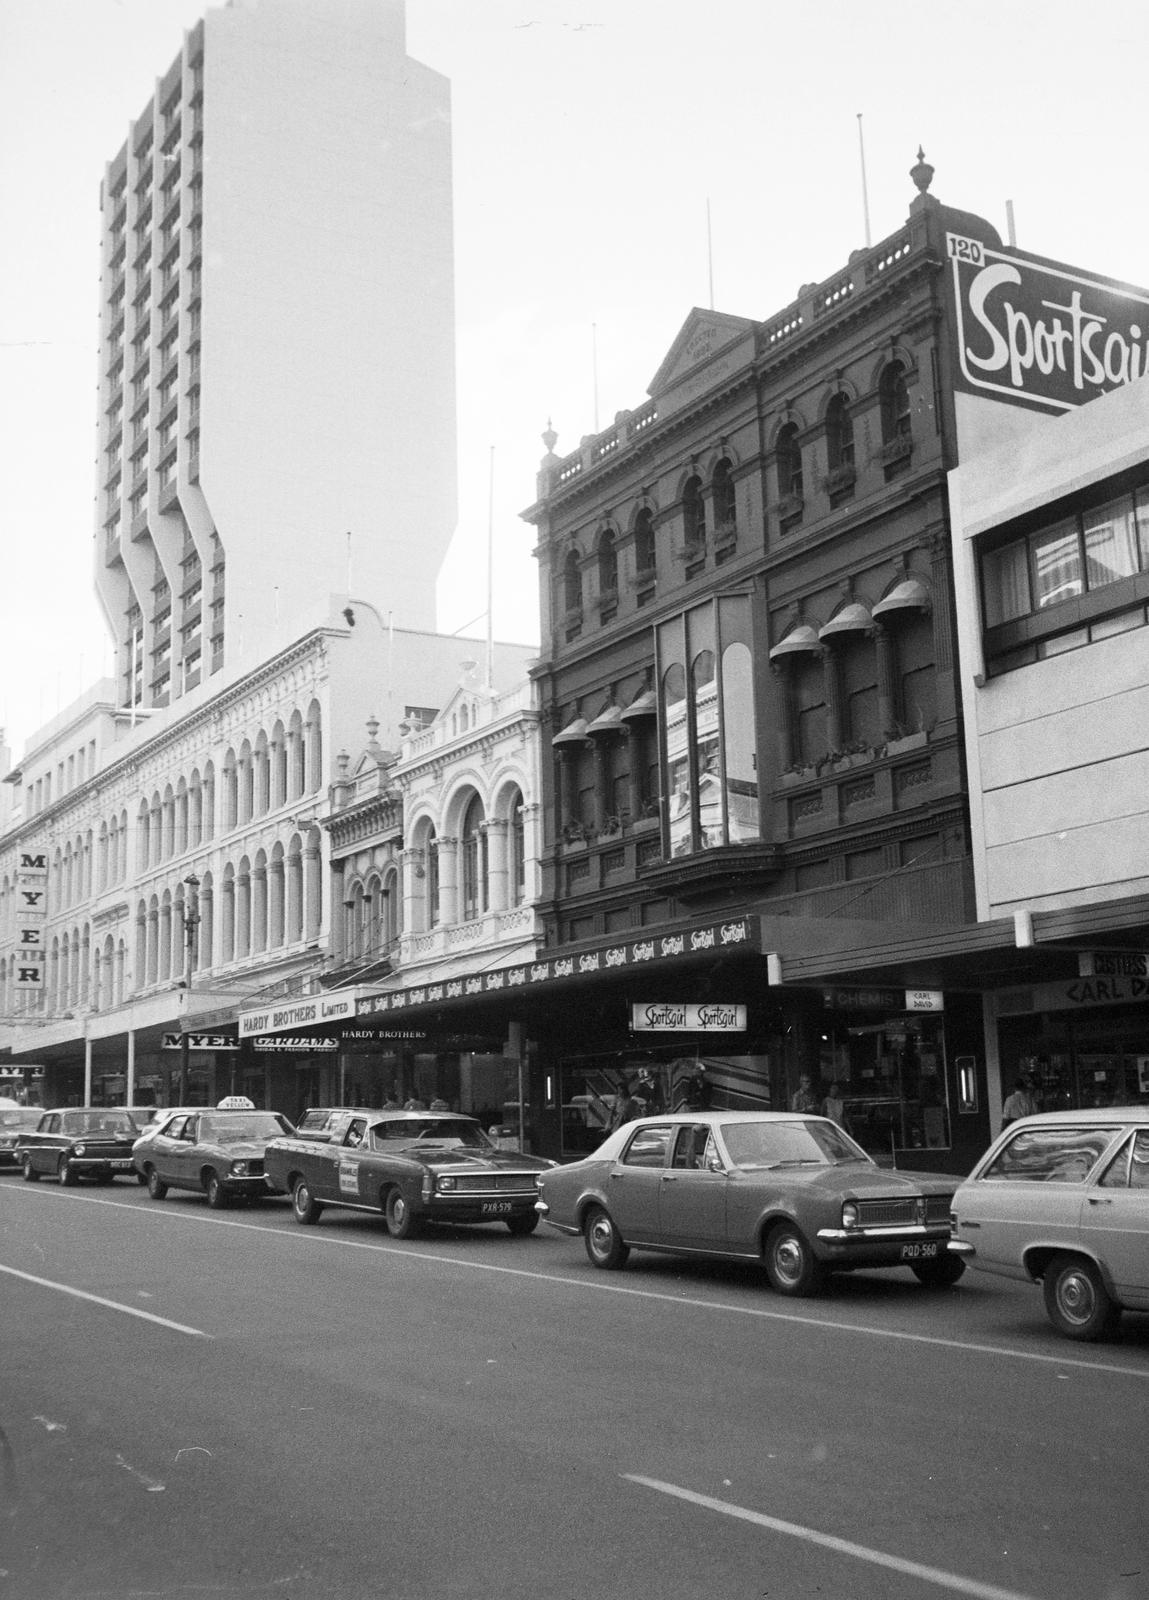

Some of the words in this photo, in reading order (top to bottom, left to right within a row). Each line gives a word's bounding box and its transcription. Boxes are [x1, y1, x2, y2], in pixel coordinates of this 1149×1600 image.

[950, 238, 981, 263] 120
[18, 854, 46, 982] MYER
[720, 921, 746, 945] Sportsgirl
[1066, 979, 1124, 1002] CARL
[243, 1015, 269, 1033] HARDY
[273, 1005, 316, 1027] BROTHERS
[645, 1004, 687, 1029] Sportsgirl
[697, 1005, 738, 1029] Sportsgirl
[164, 1034, 240, 1047] MYER
[342, 1030, 375, 1038] HARDY
[379, 1030, 426, 1039] BROTHERS
